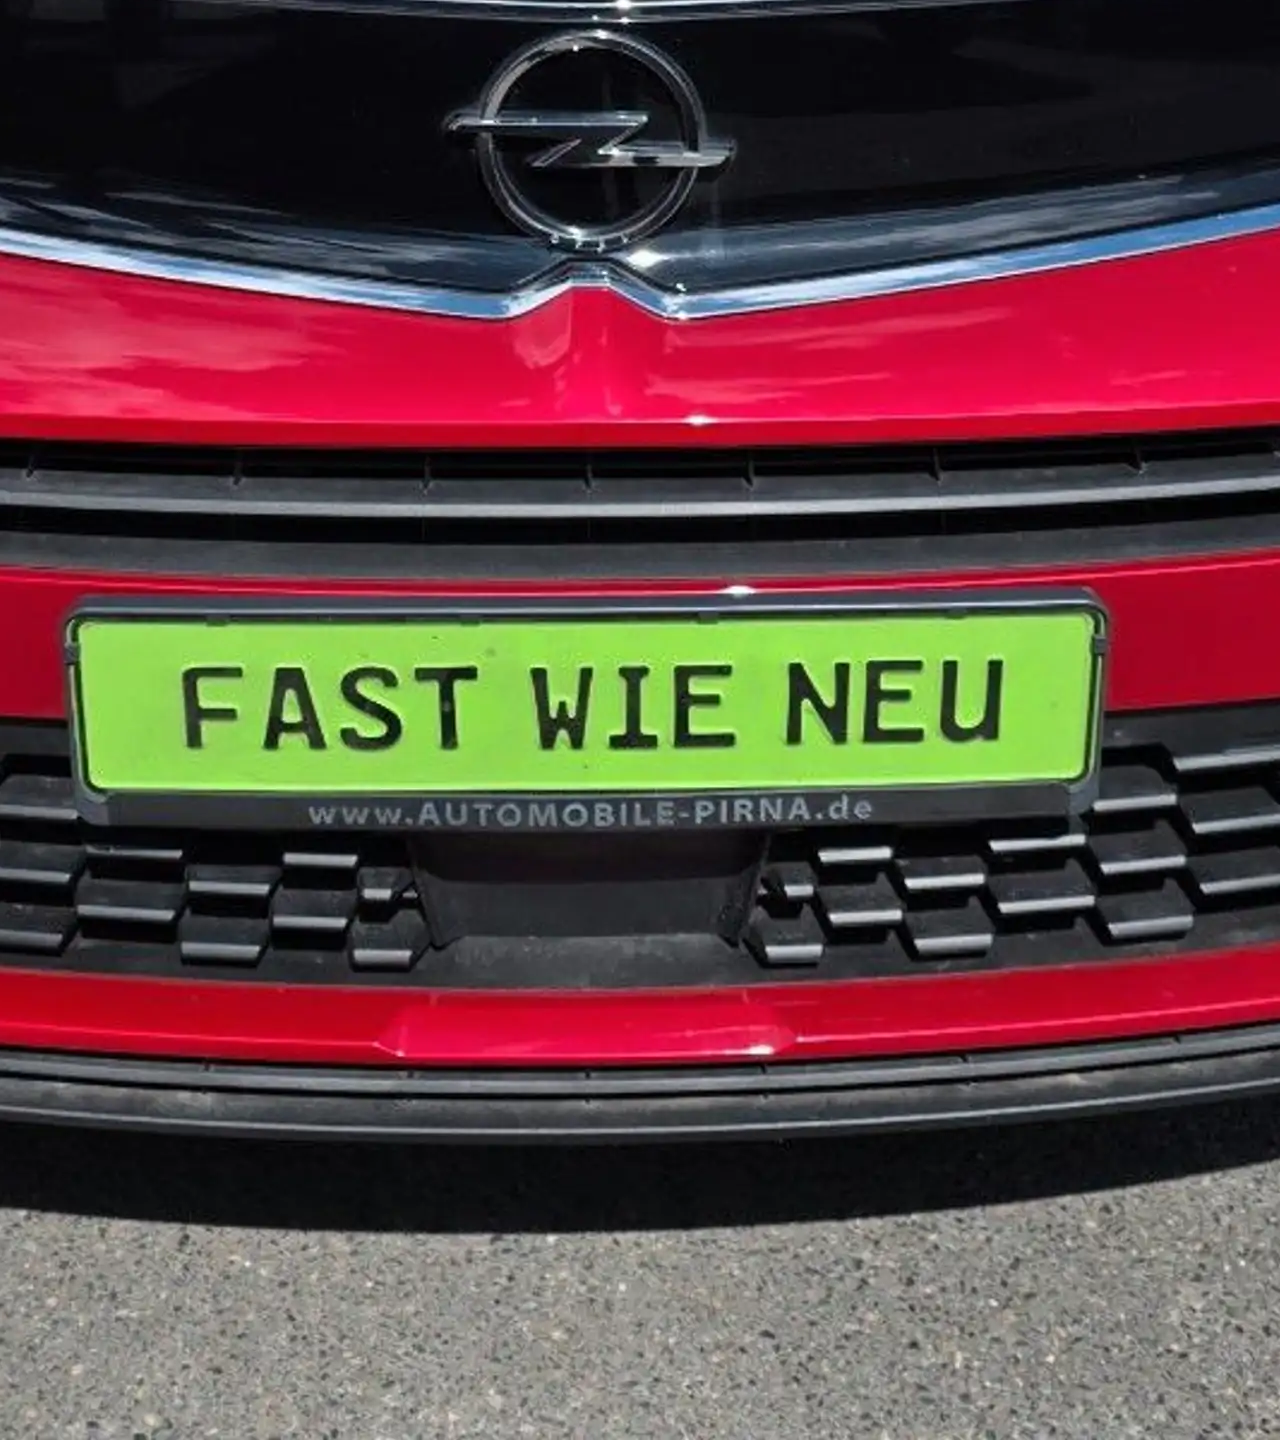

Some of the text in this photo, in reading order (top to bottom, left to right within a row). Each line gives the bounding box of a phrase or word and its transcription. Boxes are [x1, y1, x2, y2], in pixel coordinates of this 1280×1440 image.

[181, 658, 1004, 752] FAST WIE NEU
[308, 796, 874, 829] www.AUTOMOBILE-PIRNA.de
